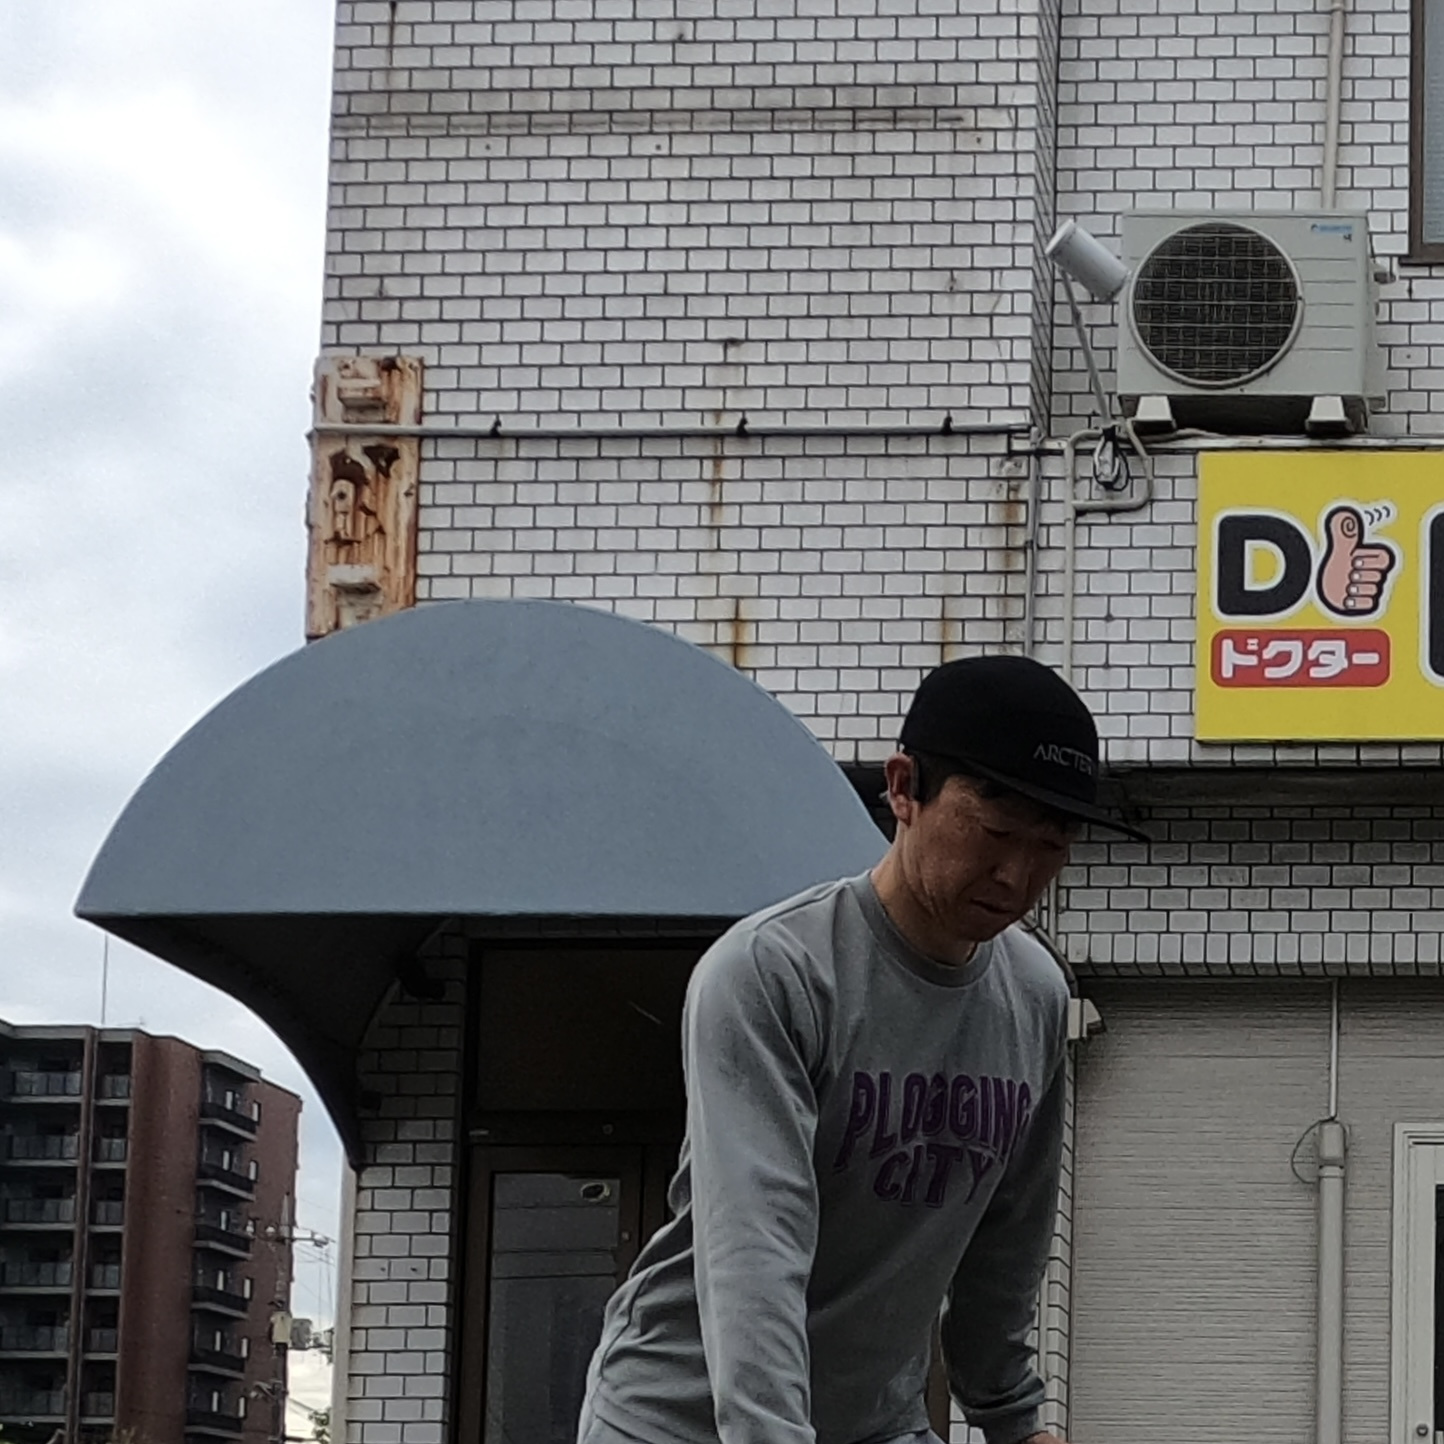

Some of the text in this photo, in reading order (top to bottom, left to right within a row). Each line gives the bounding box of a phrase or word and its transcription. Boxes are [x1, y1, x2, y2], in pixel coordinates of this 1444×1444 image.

[1220, 638, 1381, 680] ドクター
[873, 1142, 998, 1209] CITY
